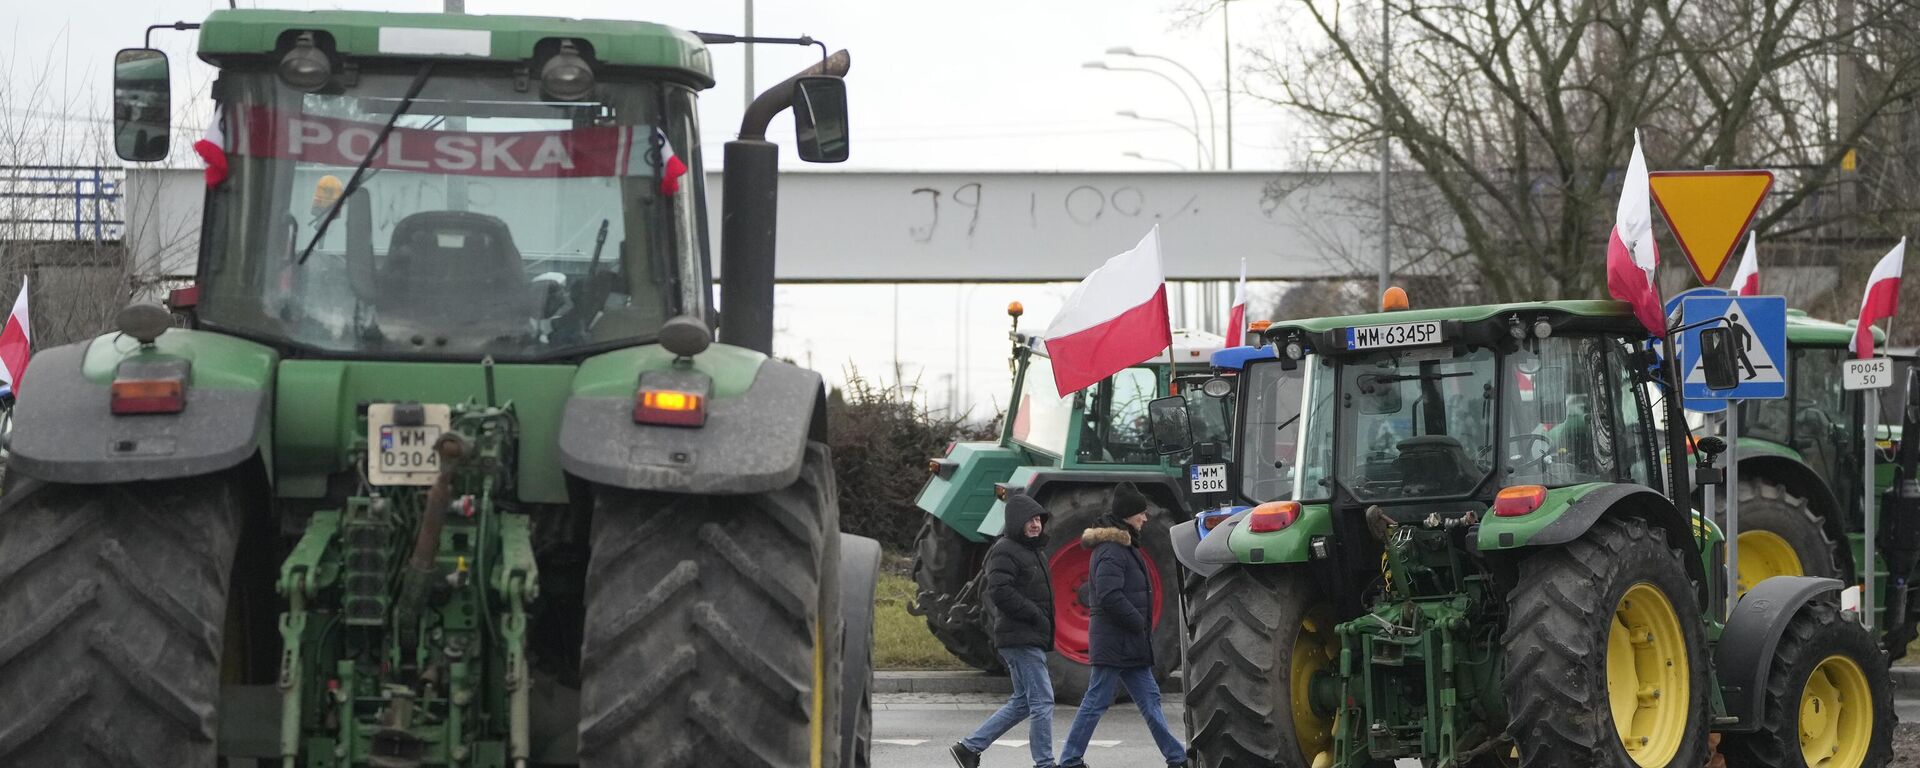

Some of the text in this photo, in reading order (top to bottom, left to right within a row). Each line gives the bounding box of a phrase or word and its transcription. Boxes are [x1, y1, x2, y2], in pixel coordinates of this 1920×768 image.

[287, 117, 575, 171] POLSKA
[1357, 327, 1380, 347] WM
[1385, 323, 1436, 344] 6345P
[1851, 362, 1885, 374] P0045
[400, 429, 426, 447] WM
[384, 450, 438, 467] 0304
[1201, 467, 1218, 478] WM
[1194, 479, 1224, 490] 580K
